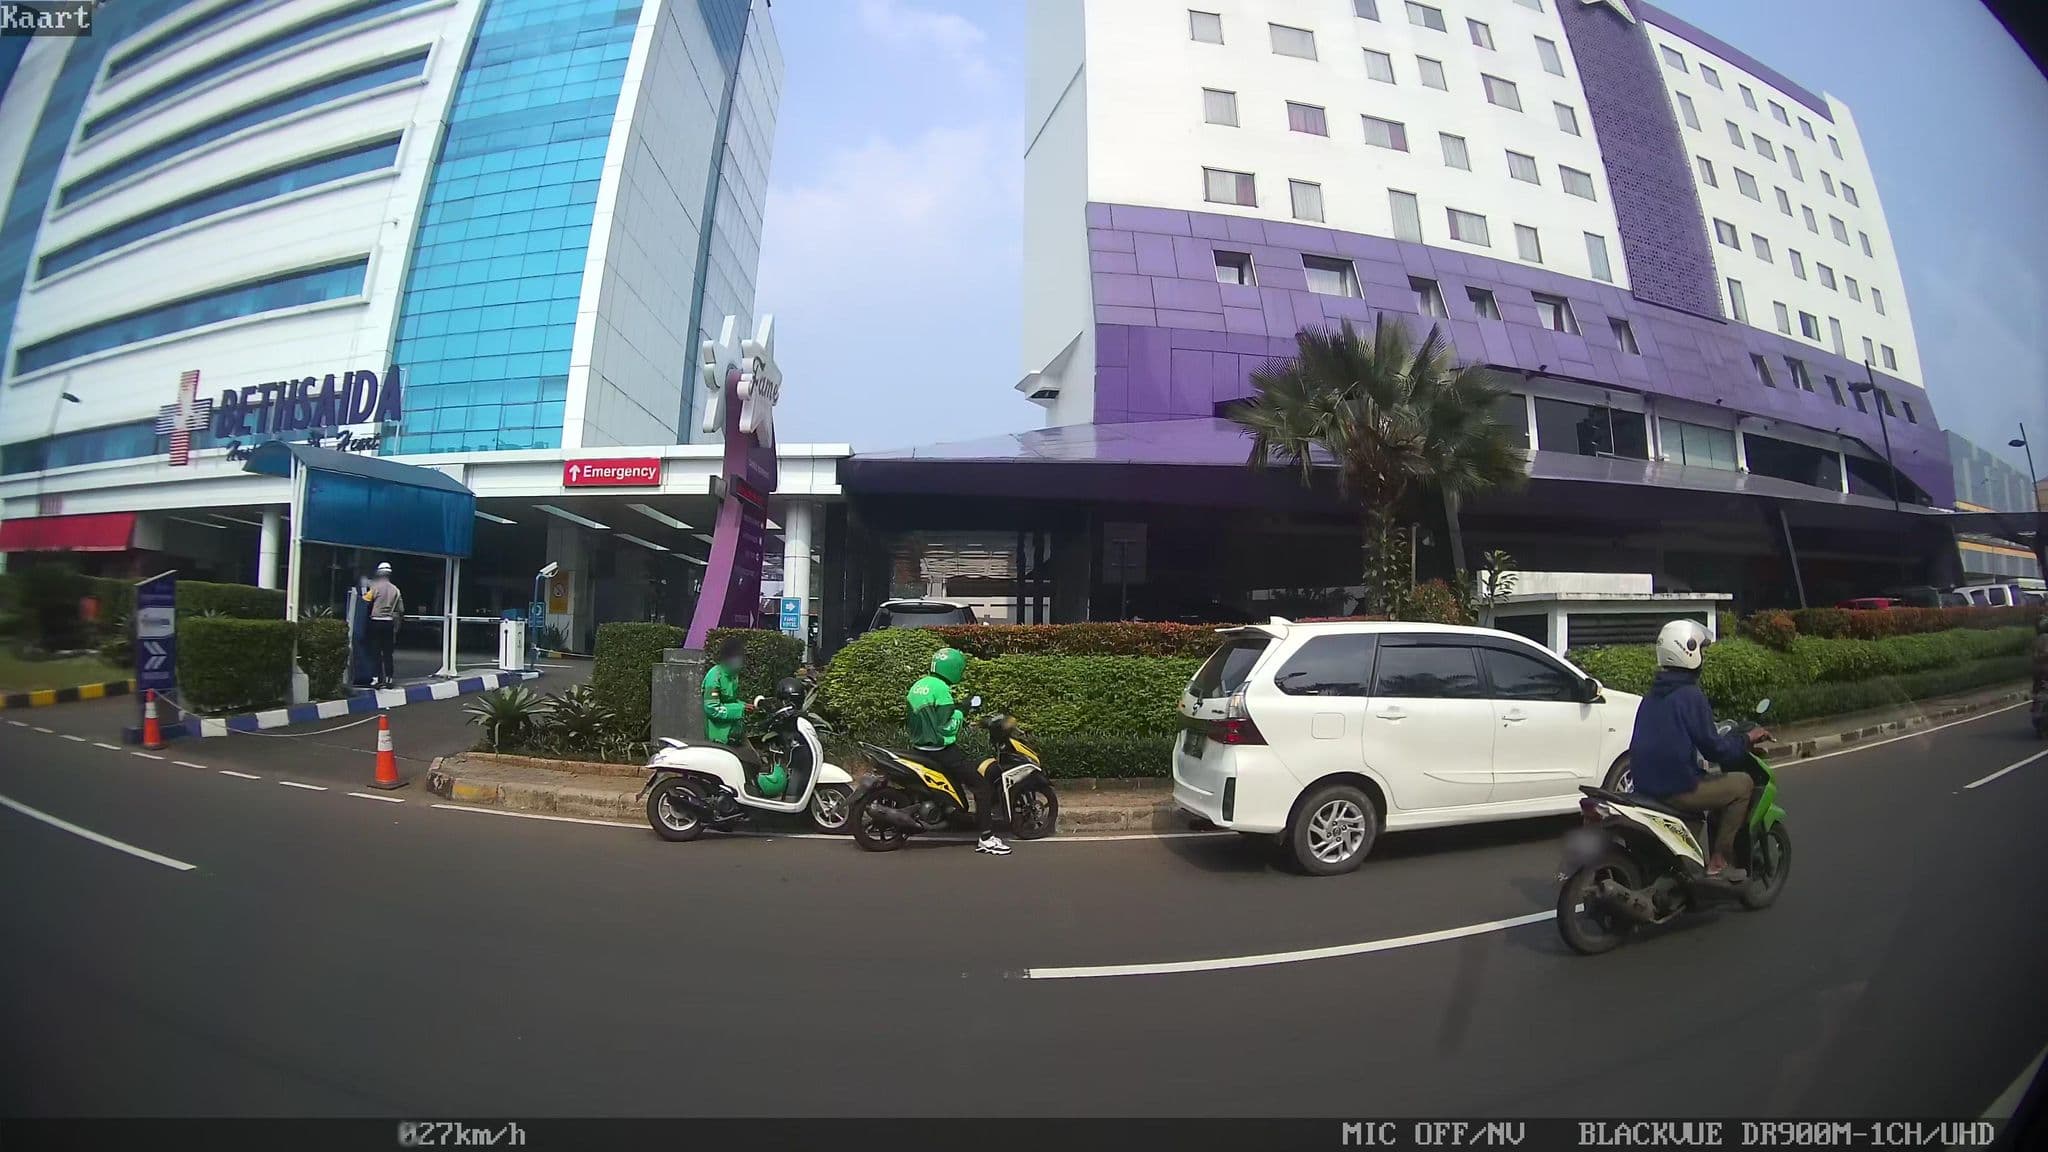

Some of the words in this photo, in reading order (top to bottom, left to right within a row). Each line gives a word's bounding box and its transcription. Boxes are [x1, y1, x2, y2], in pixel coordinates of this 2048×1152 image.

[216, 364, 402, 438] BETHSAIDA
[748, 356, 780, 406] Fame
[583, 464, 657, 480] Emergency
